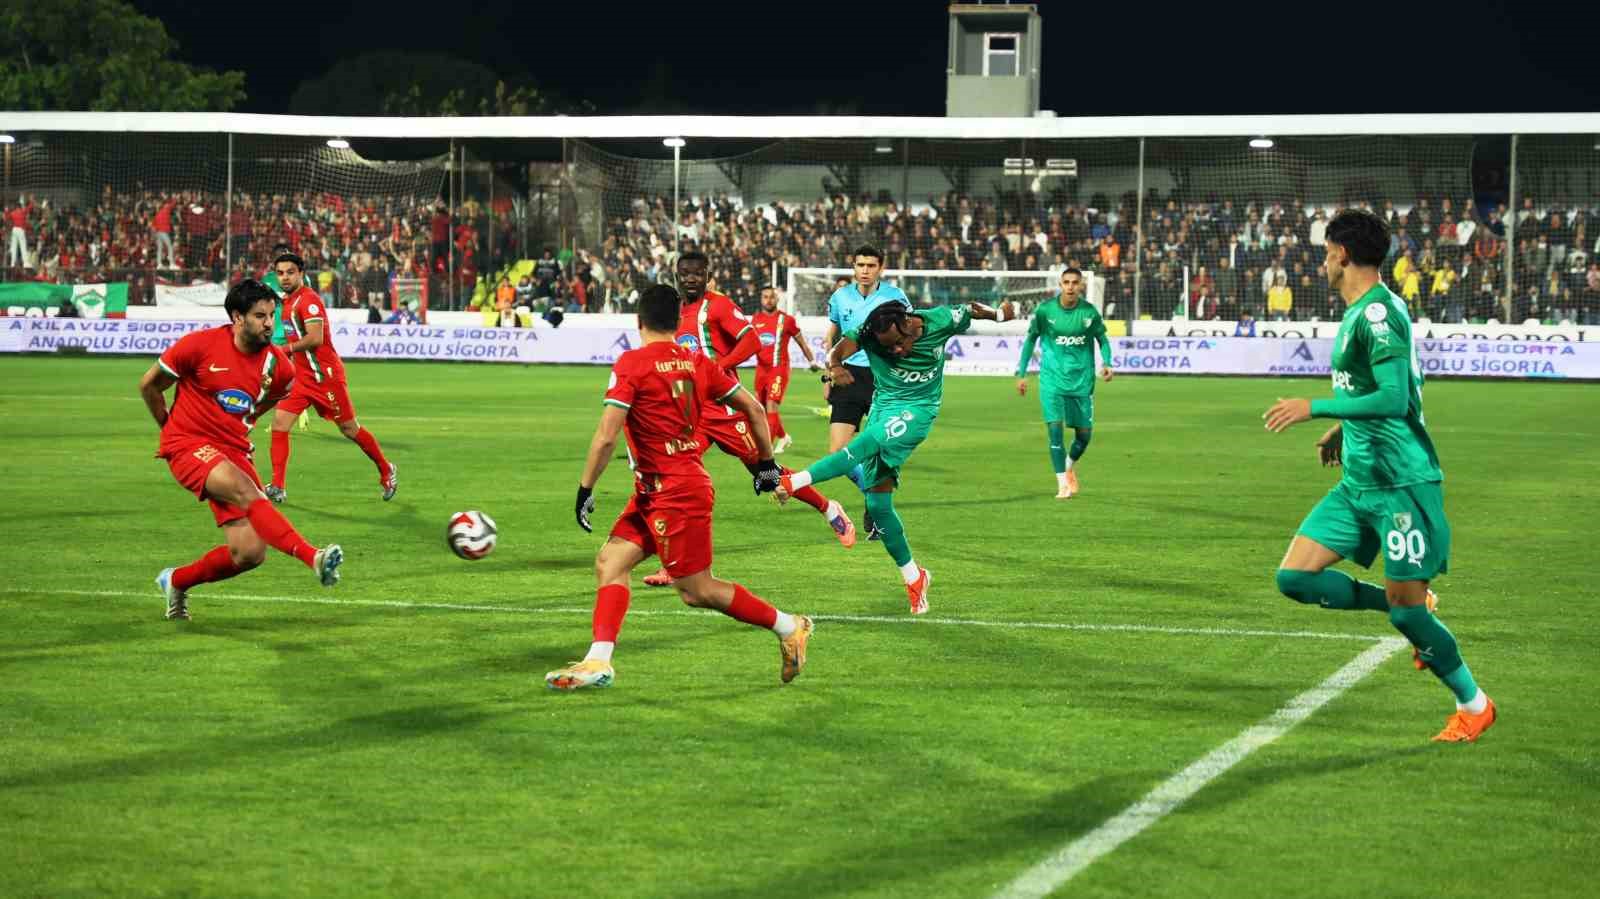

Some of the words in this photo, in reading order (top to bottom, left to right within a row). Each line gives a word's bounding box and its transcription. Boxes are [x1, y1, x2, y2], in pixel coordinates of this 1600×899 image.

[29, 334, 114, 350] ANADOLU
[354, 341, 440, 356] ANADOLU
[1386, 528, 1426, 563] 90
